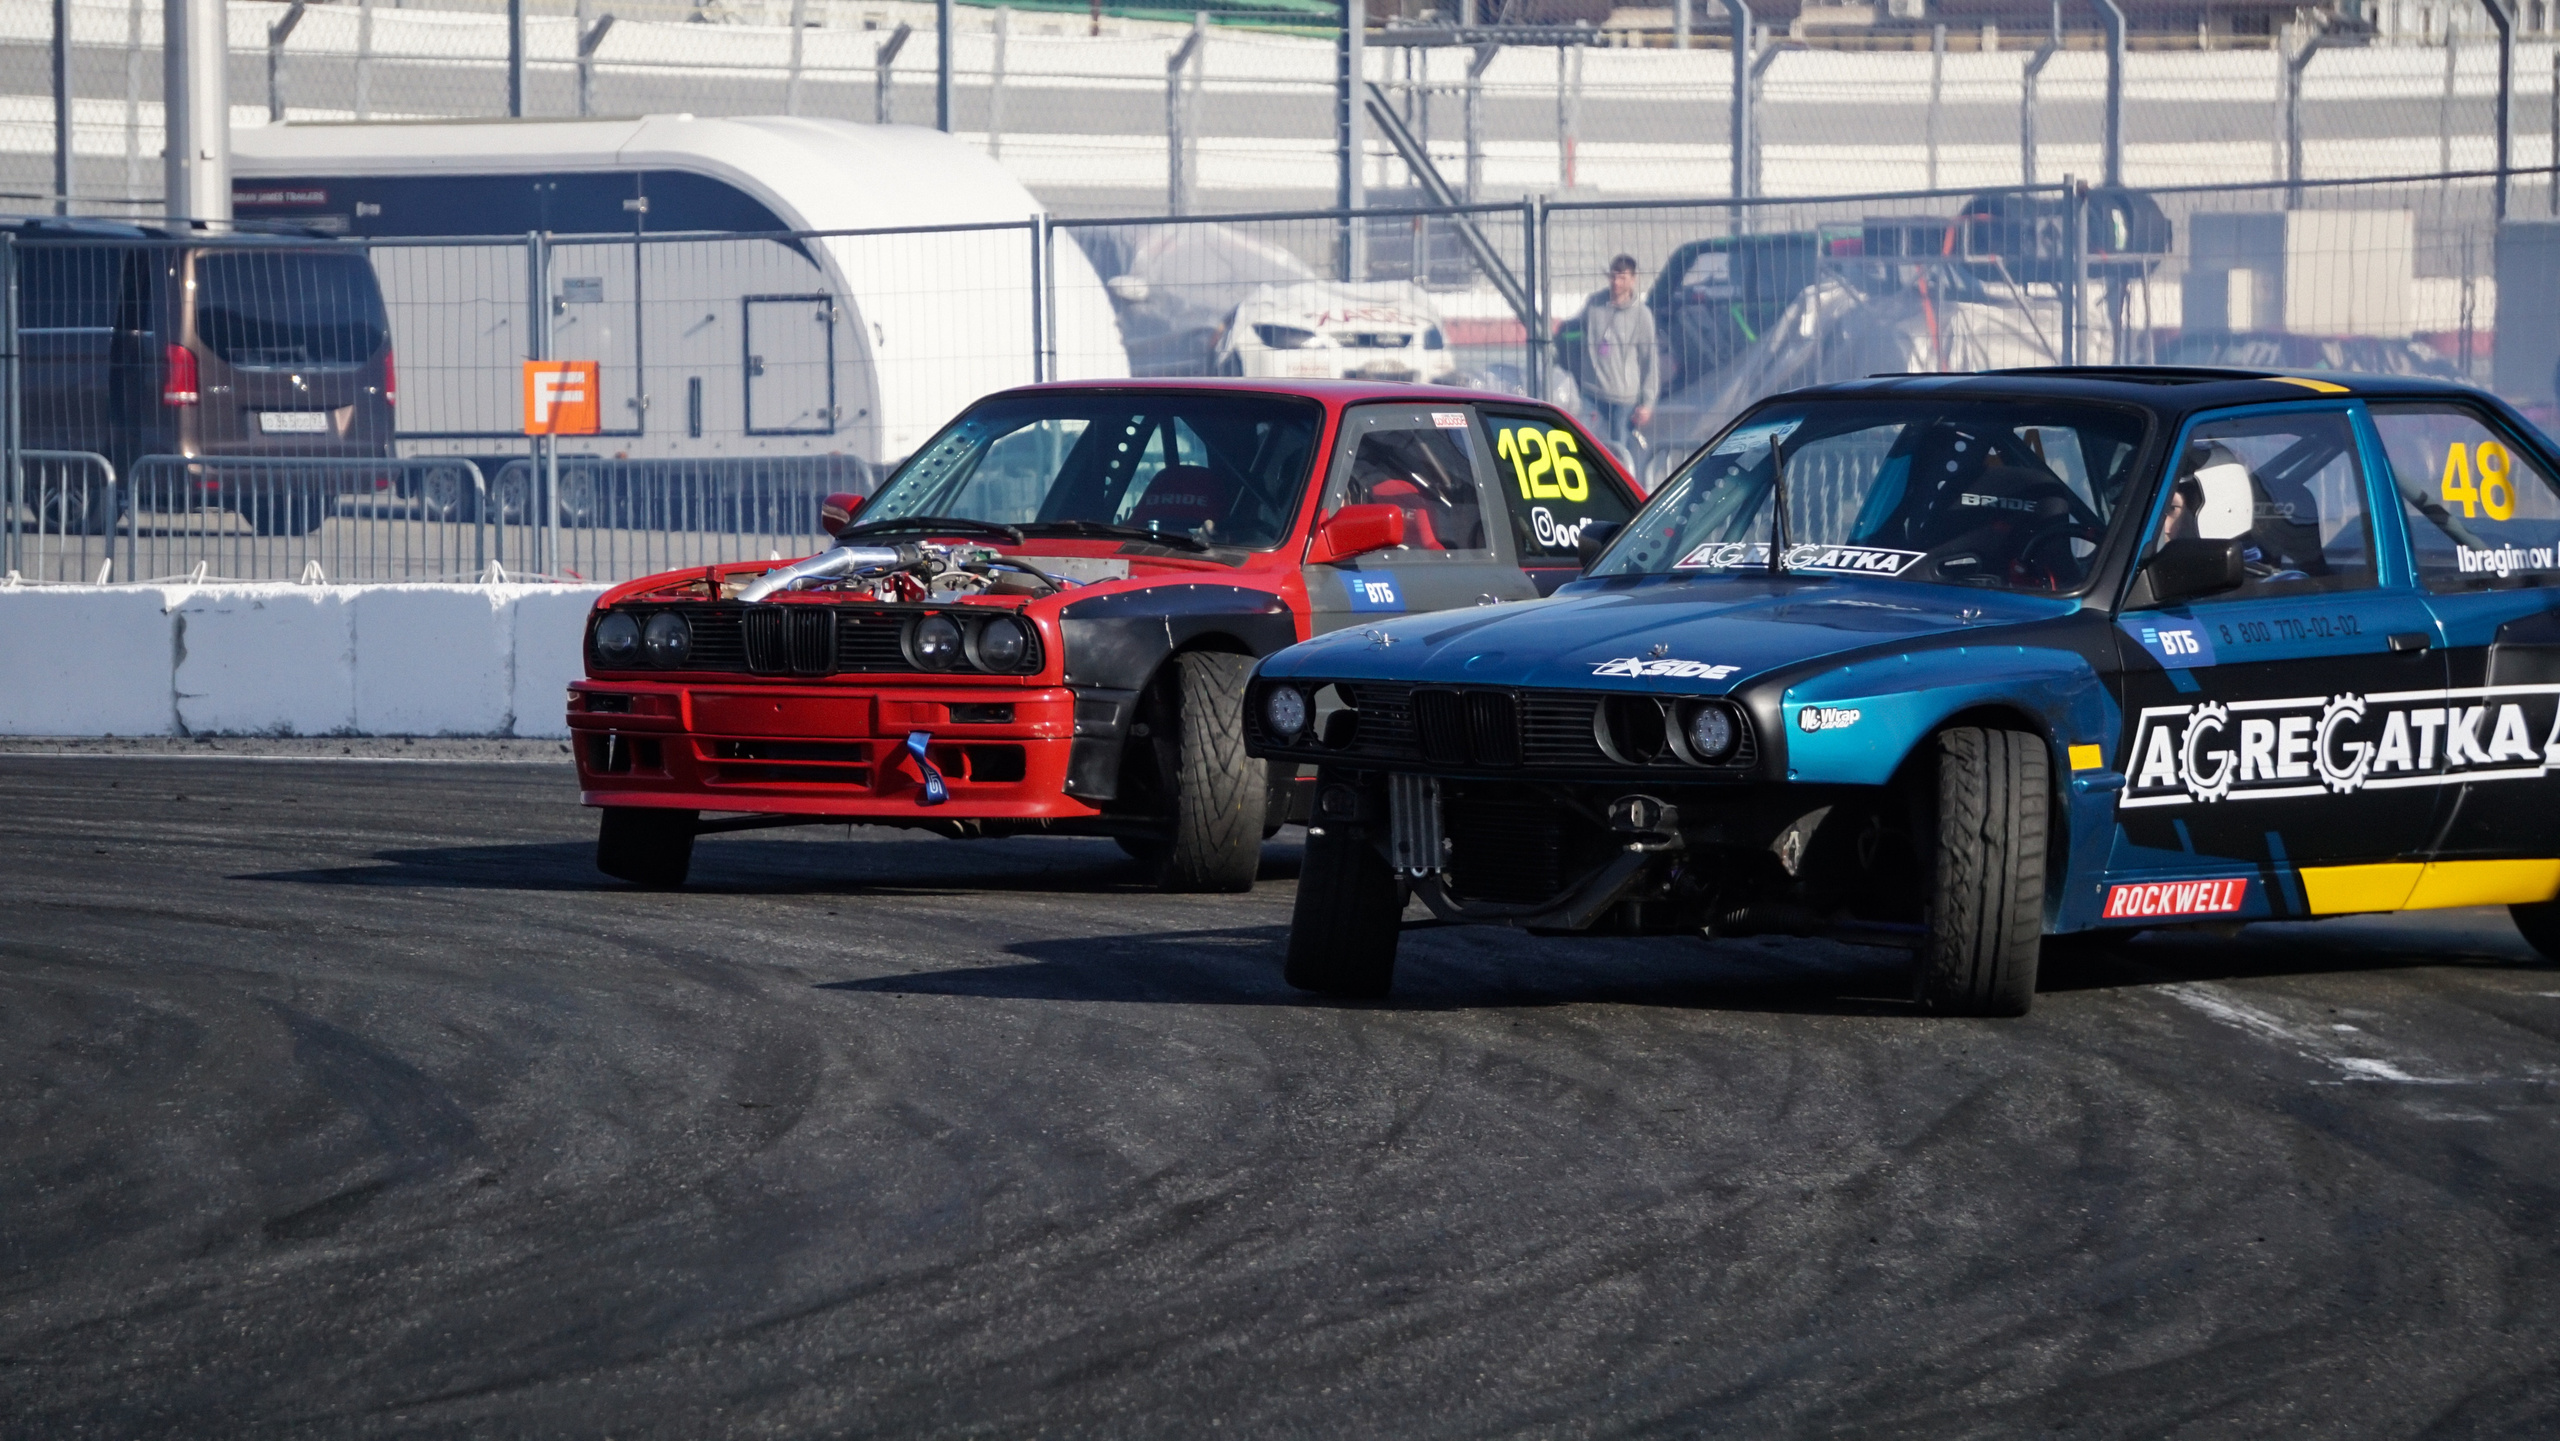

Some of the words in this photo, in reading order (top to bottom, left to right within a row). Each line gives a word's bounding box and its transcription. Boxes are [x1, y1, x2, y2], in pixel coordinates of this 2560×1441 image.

[534, 371, 585, 423] F
[1498, 427, 1588, 502] 126
[2441, 441, 2516, 521] 48
[1961, 493, 2038, 512] BRIDE
[2456, 543, 2552, 578] Ibragimov
[1365, 582, 1394, 603] ВТБ
[2158, 630, 2199, 655] ВТБ
[2220, 624, 2233, 644] 8
[2238, 621, 2271, 643] 800
[2273, 614, 2361, 640] 770-02-02
[1820, 708, 1860, 724] Wrap
[2138, 692, 2540, 803] AGREGATKA
[2110, 880, 2234, 917] ROCKWELL
